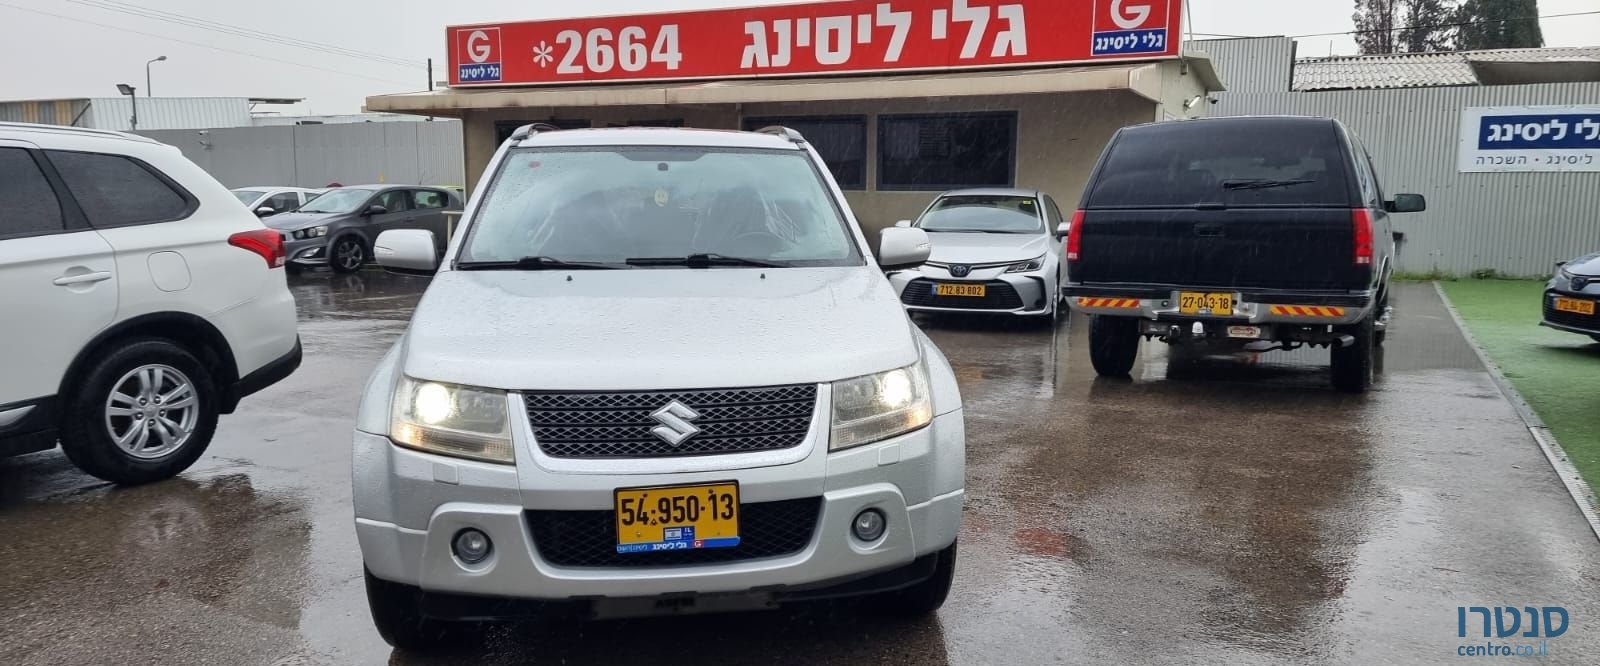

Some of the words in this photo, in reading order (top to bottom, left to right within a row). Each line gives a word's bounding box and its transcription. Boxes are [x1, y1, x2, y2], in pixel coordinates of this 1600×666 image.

[740, 2, 912, 69] ליסינג
[931, 0, 1027, 59] גלי
[1142, 32, 1164, 48] גלי
[467, 30, 491, 63] G
[1094, 33, 1138, 51] ליסינג
[1487, 118, 1568, 142] ליסינג
[1574, 118, 1600, 141] לי
[1476, 155, 1527, 165] השכרה
[1546, 153, 1593, 165] ליסינג
